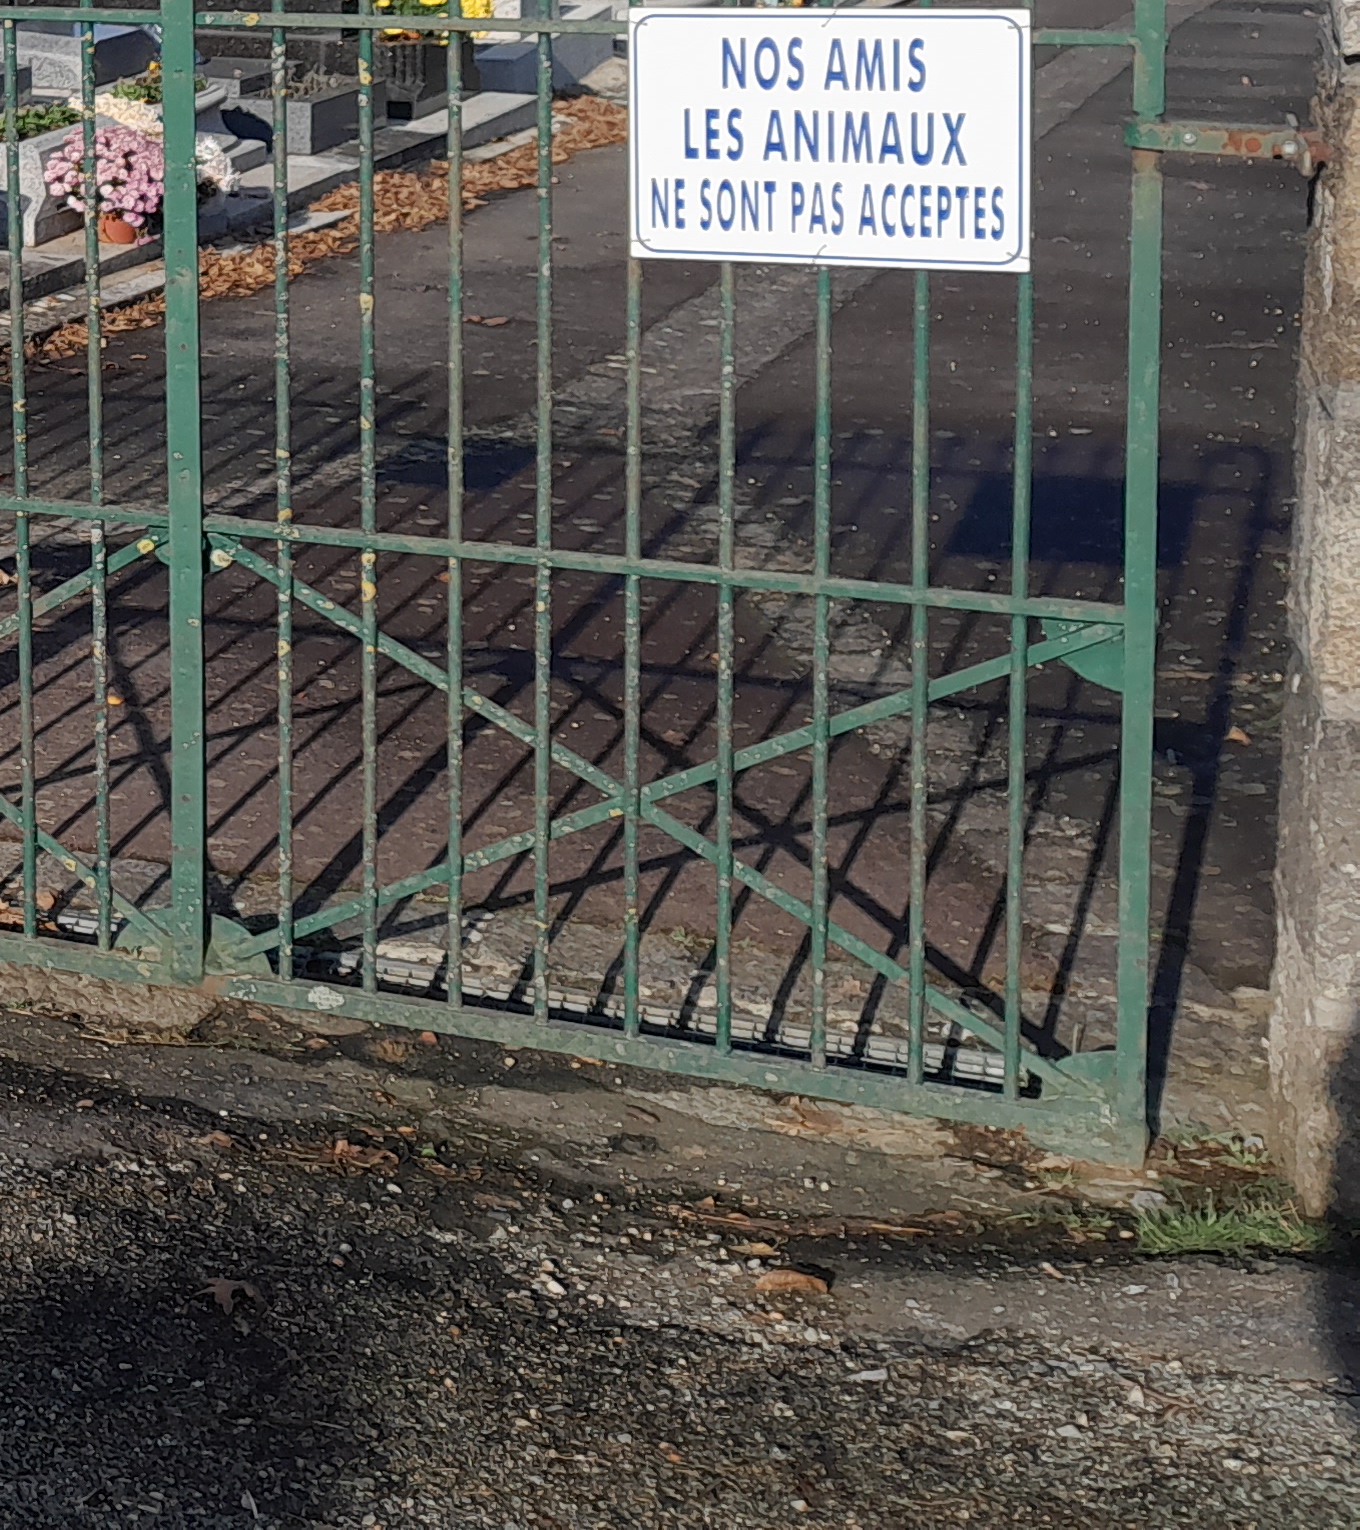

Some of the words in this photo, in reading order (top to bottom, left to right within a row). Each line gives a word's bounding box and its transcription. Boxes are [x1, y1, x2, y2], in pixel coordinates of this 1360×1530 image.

[721, 36, 804, 91] NOS
[824, 37, 926, 93] AMIS
[684, 108, 744, 161] LES
[763, 109, 968, 166] ANIMAUX
[651, 178, 686, 229] NE
[699, 178, 776, 232] SONT
[791, 181, 845, 236] PAS
[859, 184, 1005, 241] ACCEPTES
